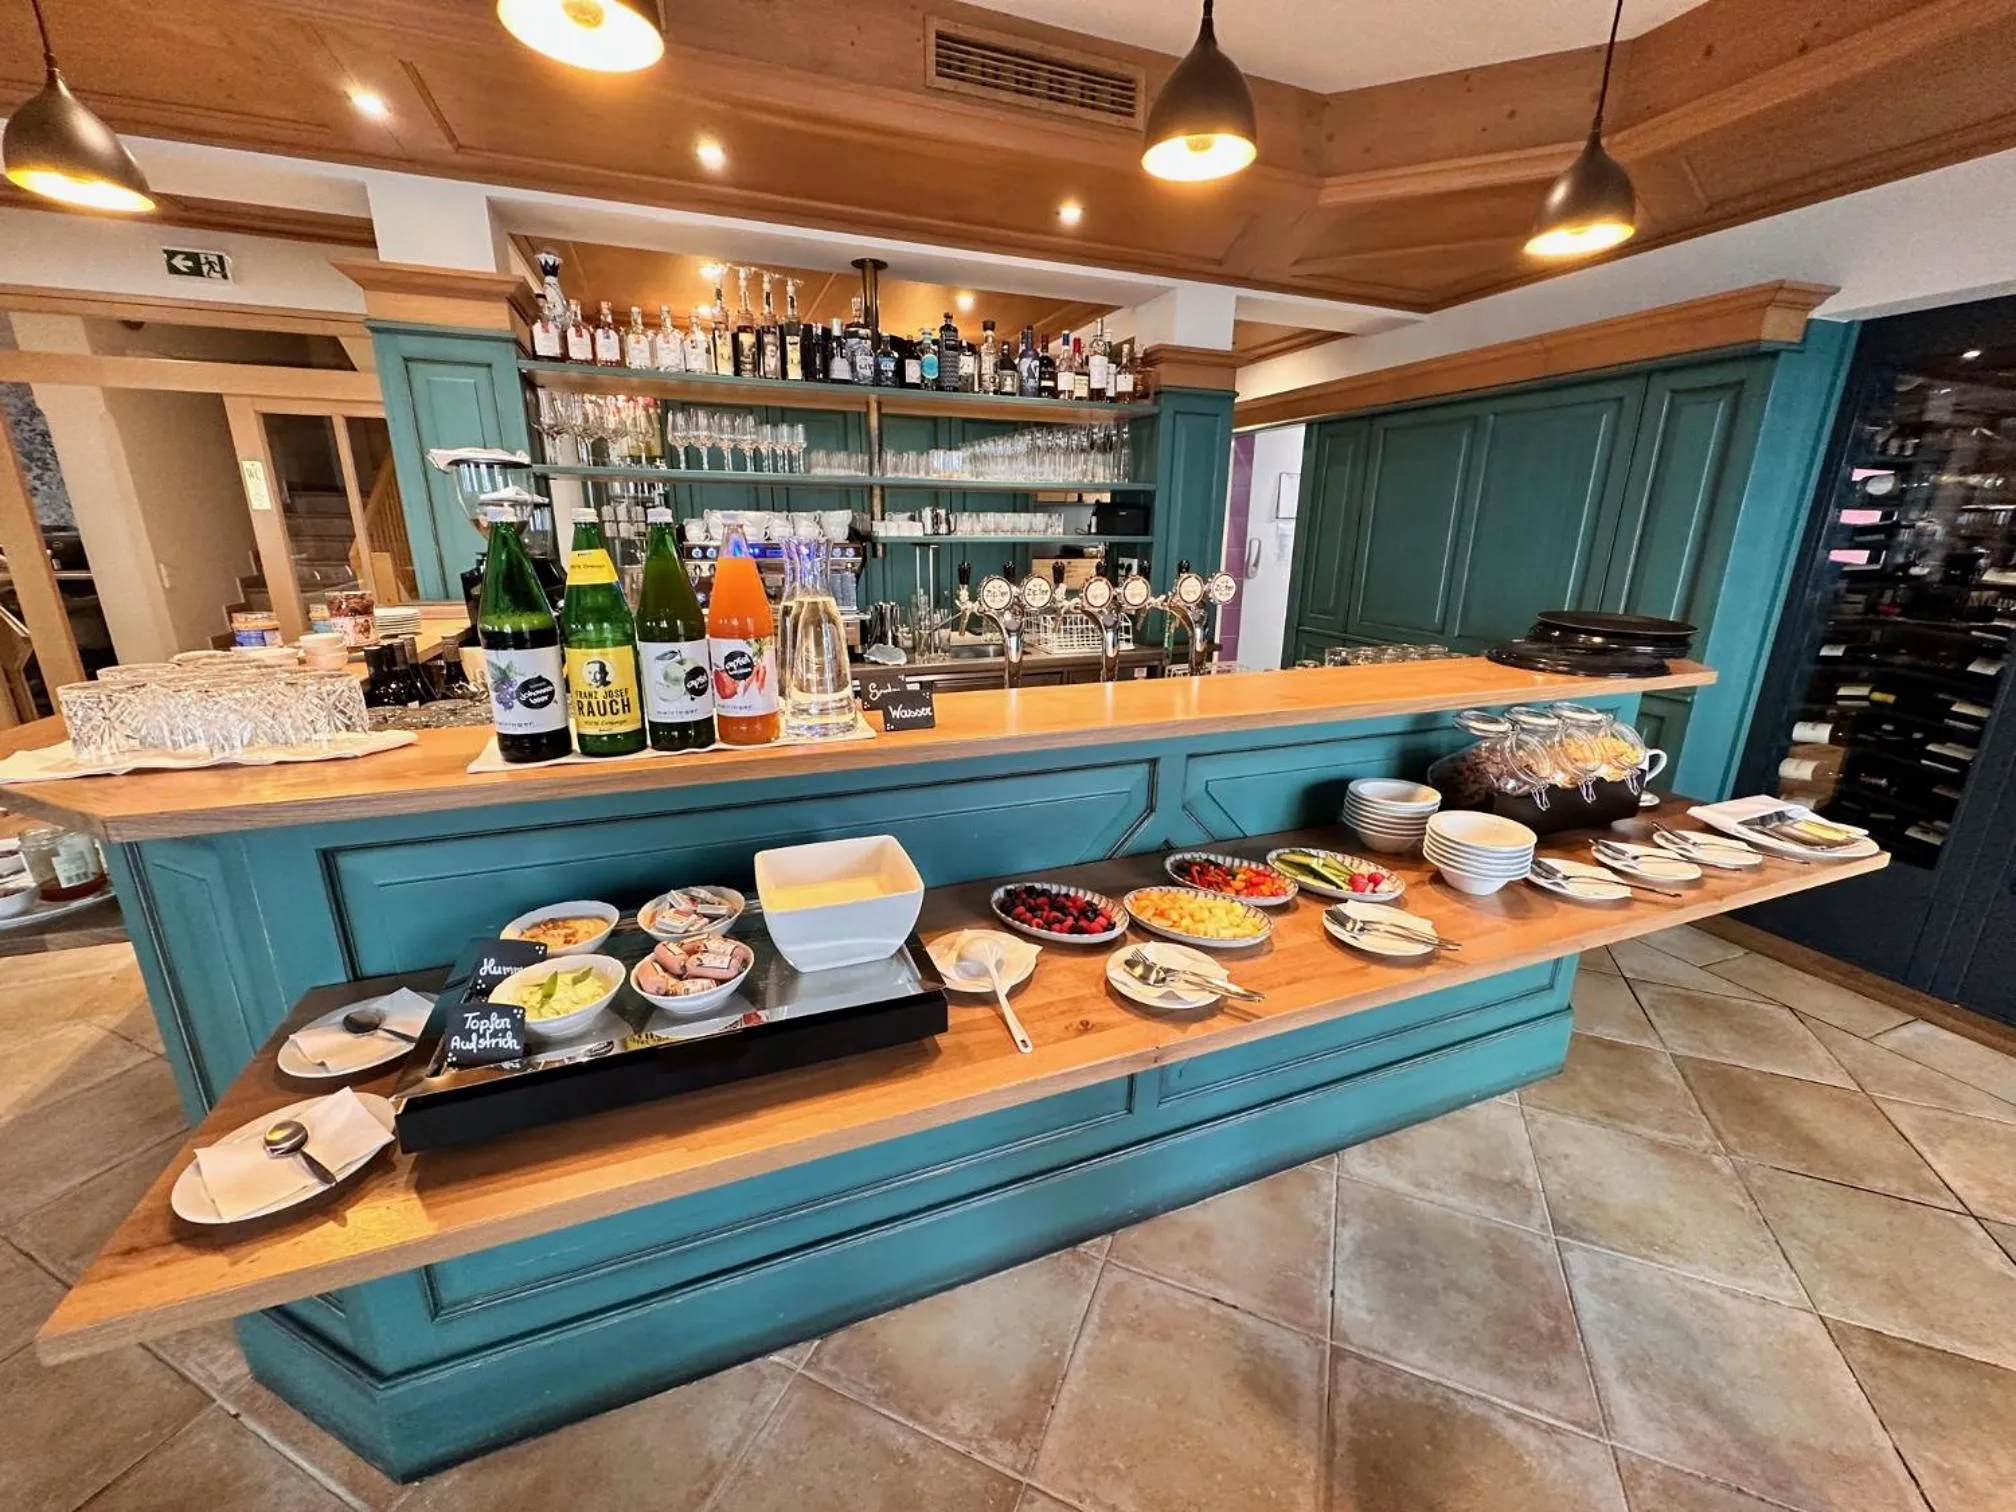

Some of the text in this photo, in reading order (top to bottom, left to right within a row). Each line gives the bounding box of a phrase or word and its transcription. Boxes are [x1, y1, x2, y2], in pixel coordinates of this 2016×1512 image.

[575, 687, 630, 700] FRANZ JOSEF
[576, 696, 632, 717] RAUCH
[887, 703, 934, 720] Wasser
[479, 957, 524, 976] Humm
[463, 1011, 512, 1034] Topfen
[450, 1029, 521, 1053] Aufstrich
